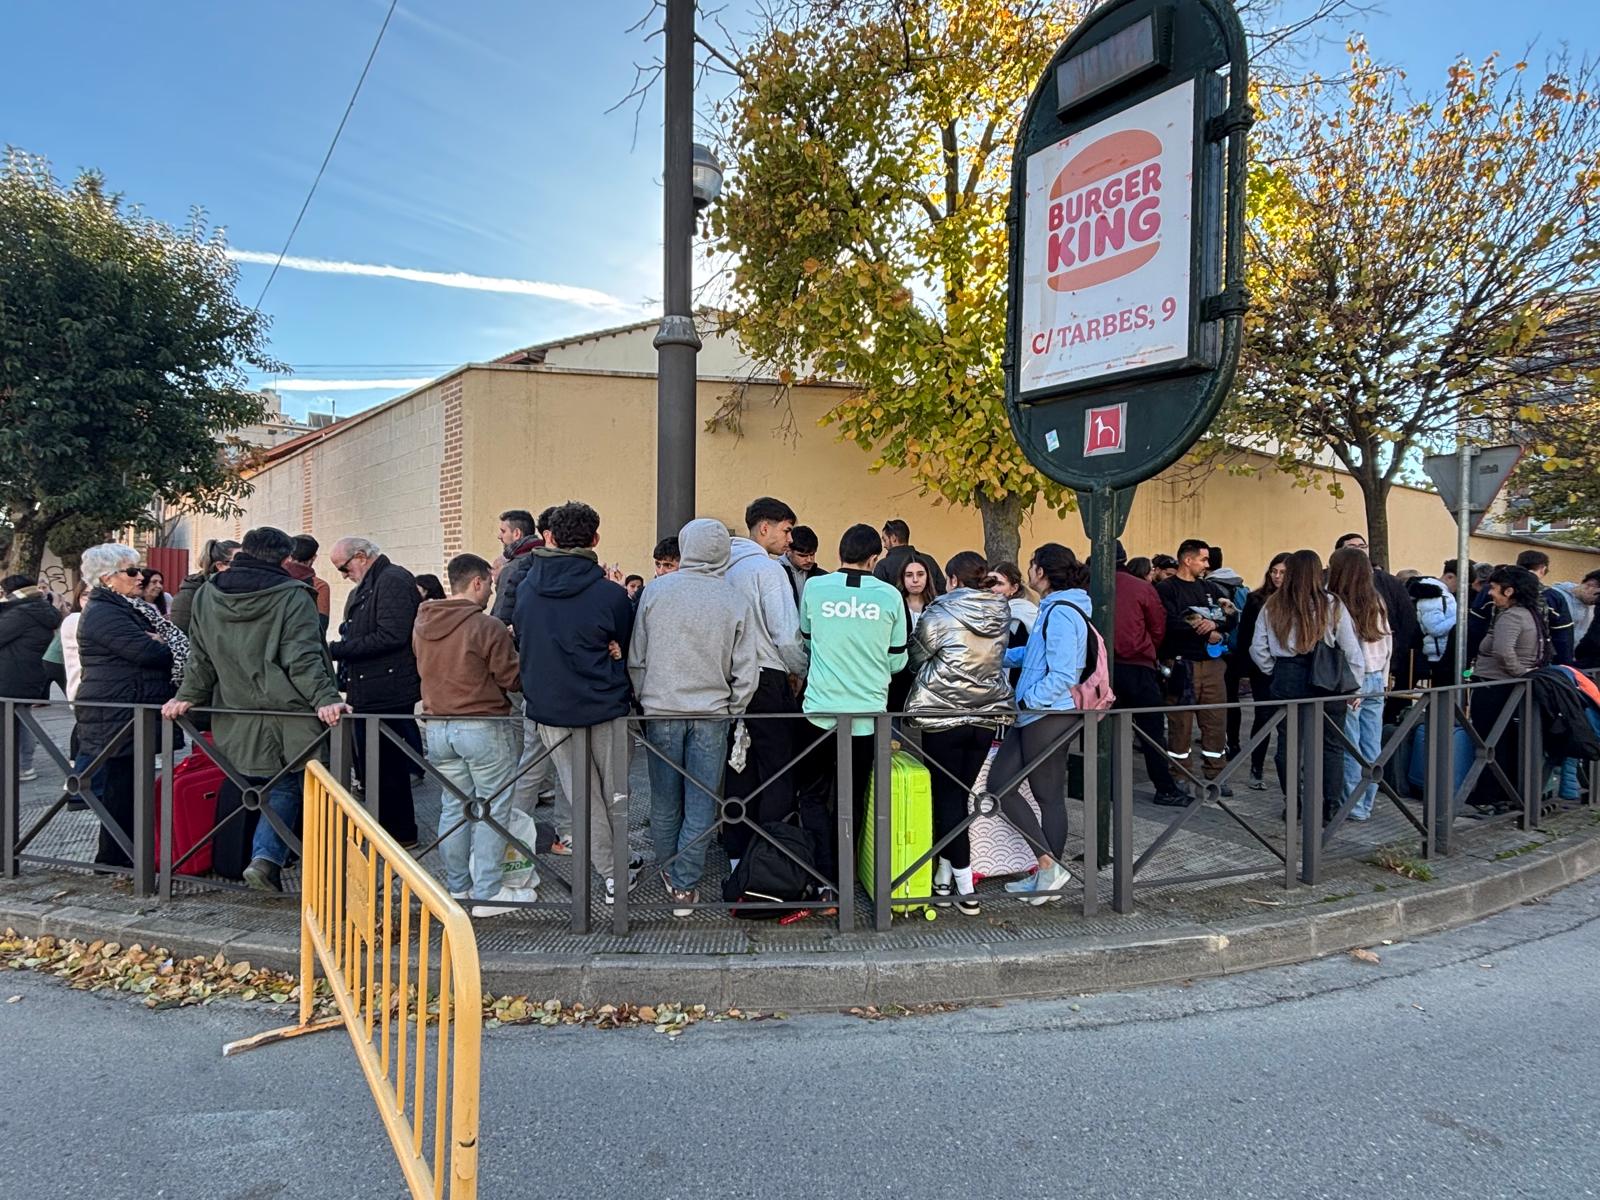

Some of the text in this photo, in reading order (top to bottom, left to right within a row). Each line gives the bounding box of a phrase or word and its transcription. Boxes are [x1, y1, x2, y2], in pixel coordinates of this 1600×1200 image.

[1049, 163, 1161, 231] BURGER
[1048, 196, 1161, 272] KING
[1032, 297, 1176, 354] C/ TARBES, 9
[821, 596, 880, 620] soka
